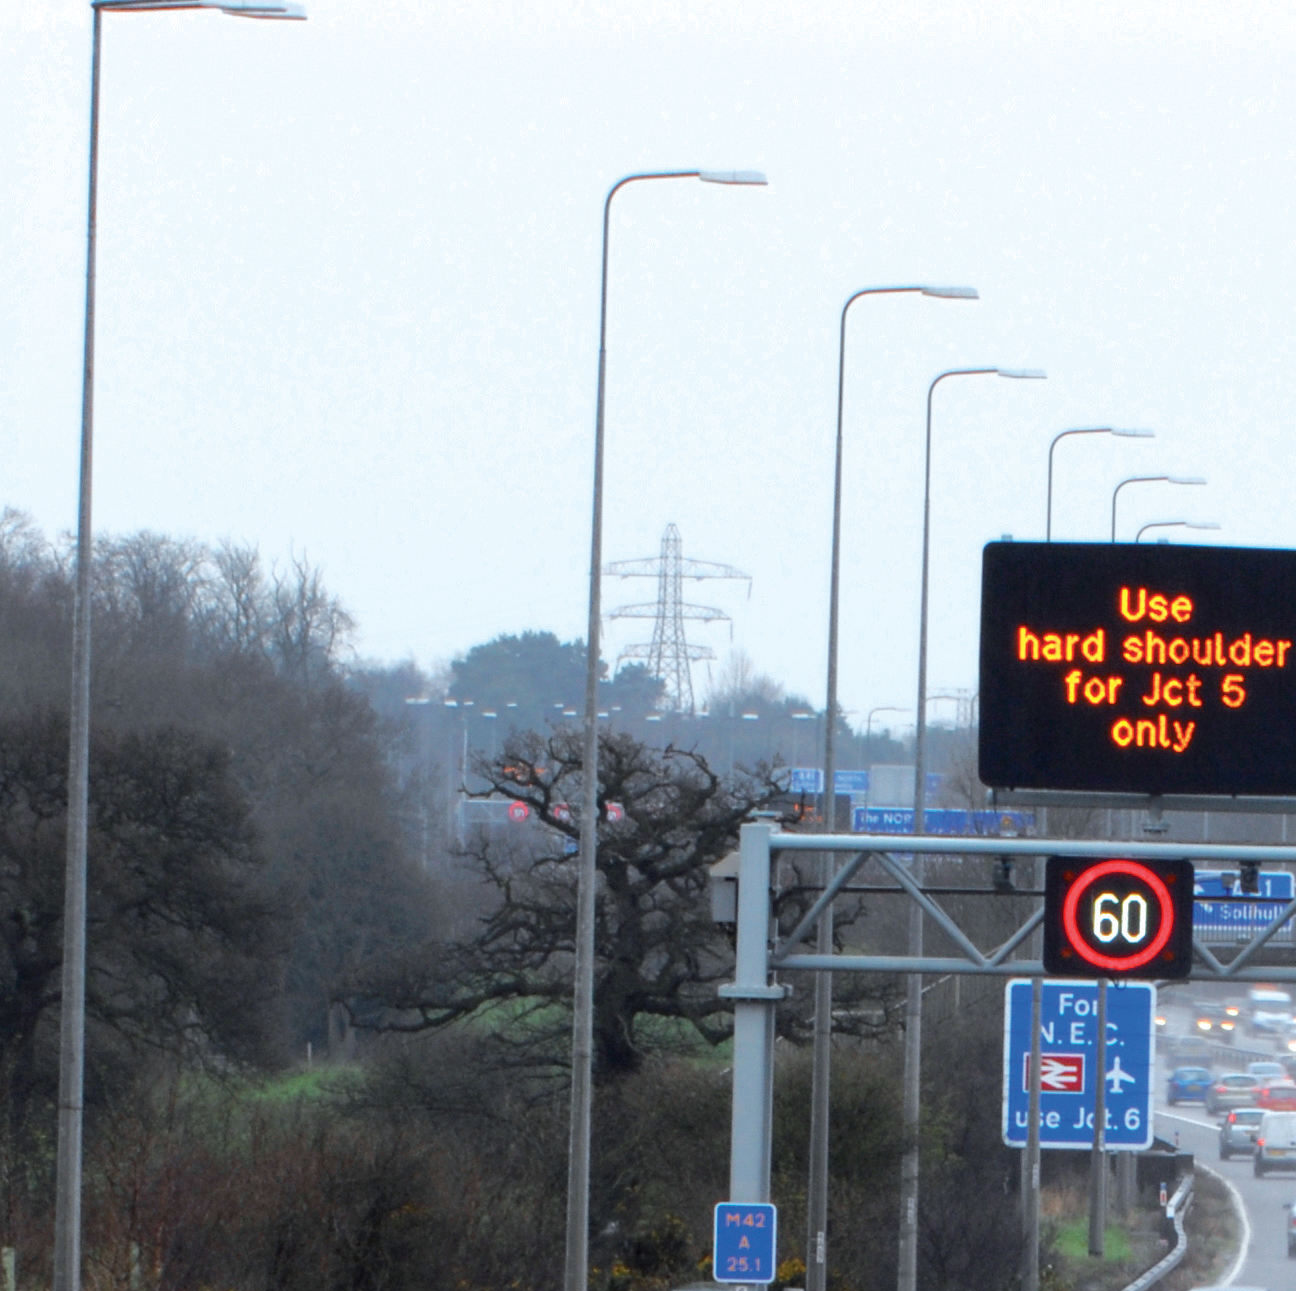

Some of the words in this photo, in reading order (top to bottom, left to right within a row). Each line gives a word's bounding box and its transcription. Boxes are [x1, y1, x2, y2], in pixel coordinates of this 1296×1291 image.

[1119, 586, 1193, 622] Use
[1018, 626, 1106, 662] hard
[1122, 630, 1292, 667] shoulder
[1064, 670, 1122, 705] for
[1142, 673, 1203, 707] Jct
[1221, 674, 1247, 708] 5
[1111, 714, 1196, 753] only
[1093, 893, 1148, 943] 60
[1221, 904, 1284, 920] Solihull
[1124, 1108, 1141, 1131] 6
[725, 1213, 766, 1228] M42
[739, 1236, 750, 1250] A
[727, 1257, 761, 1272] 25.1
